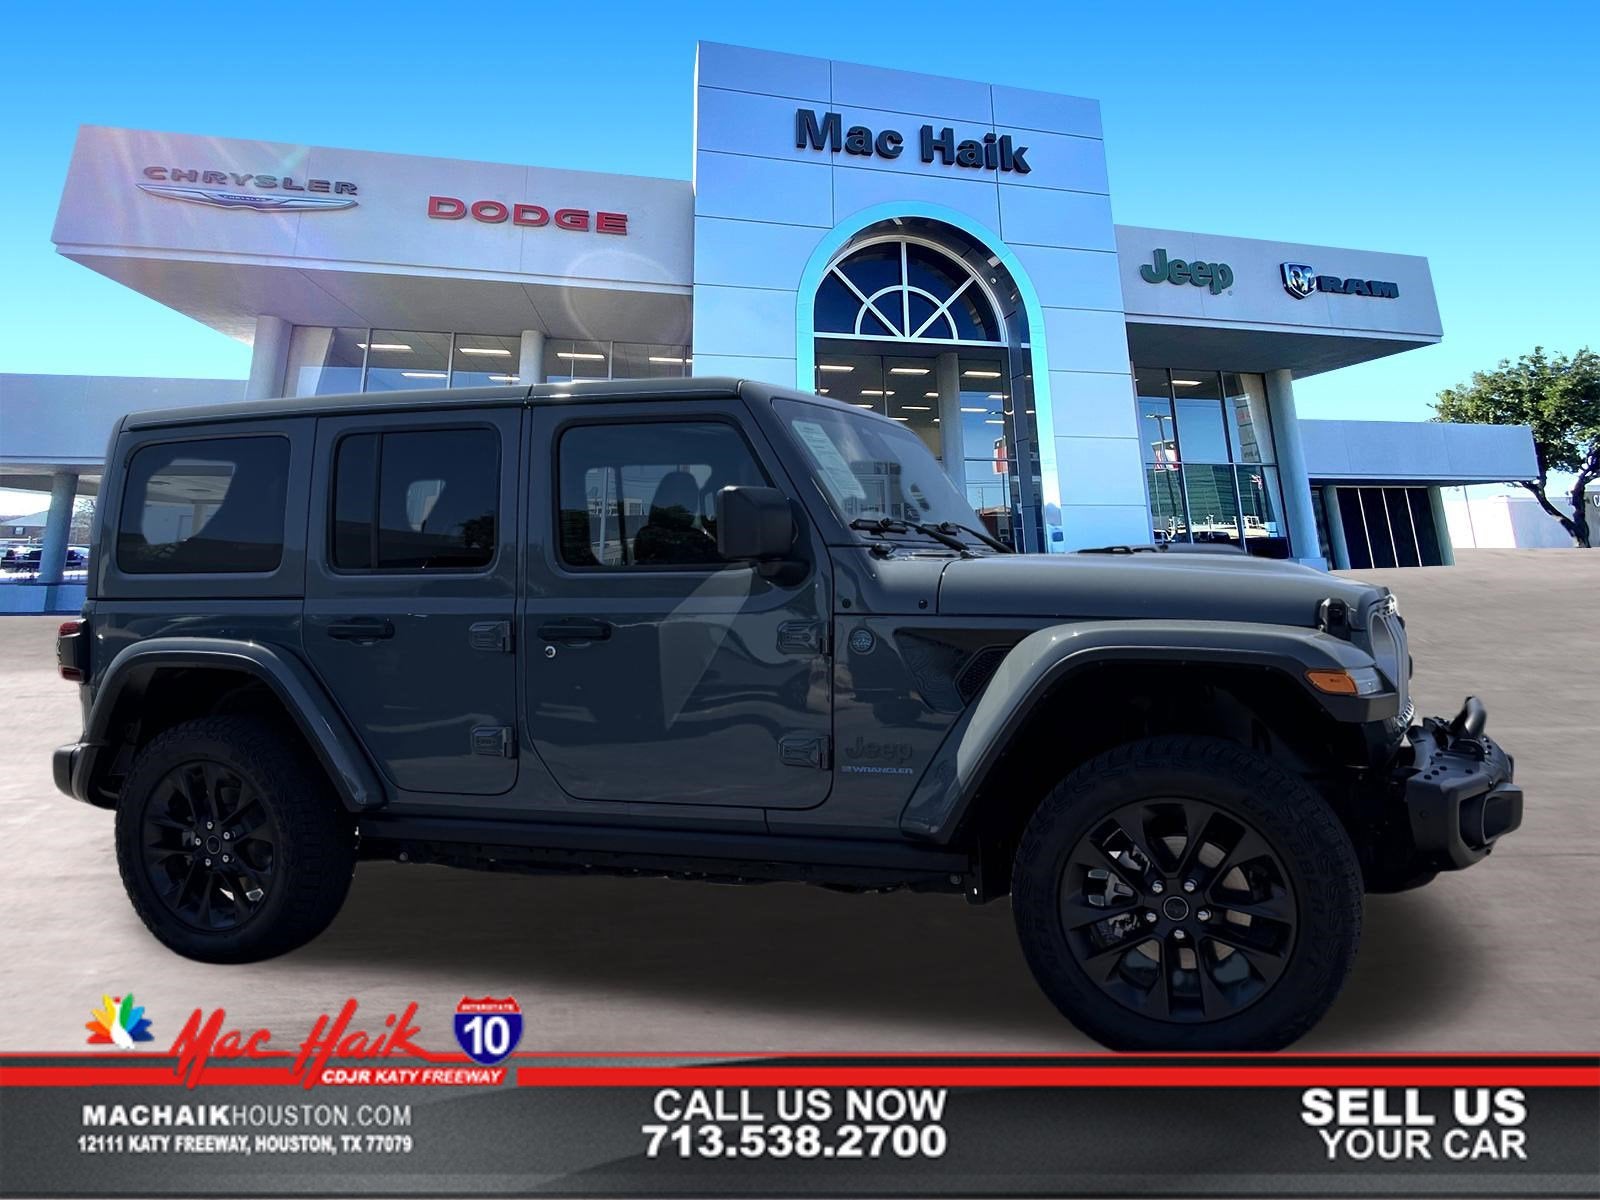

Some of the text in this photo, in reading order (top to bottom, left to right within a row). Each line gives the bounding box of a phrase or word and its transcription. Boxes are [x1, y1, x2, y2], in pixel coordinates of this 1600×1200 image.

[796, 108, 1032, 174] Mac Haik
[143, 165, 359, 196] CHRYSLER
[427, 195, 628, 236] DODGE
[1139, 248, 1234, 295] Jeep
[1316, 275, 1400, 299] RAM
[846, 736, 913, 764] Jeep
[852, 765, 913, 774] WRANGLER
